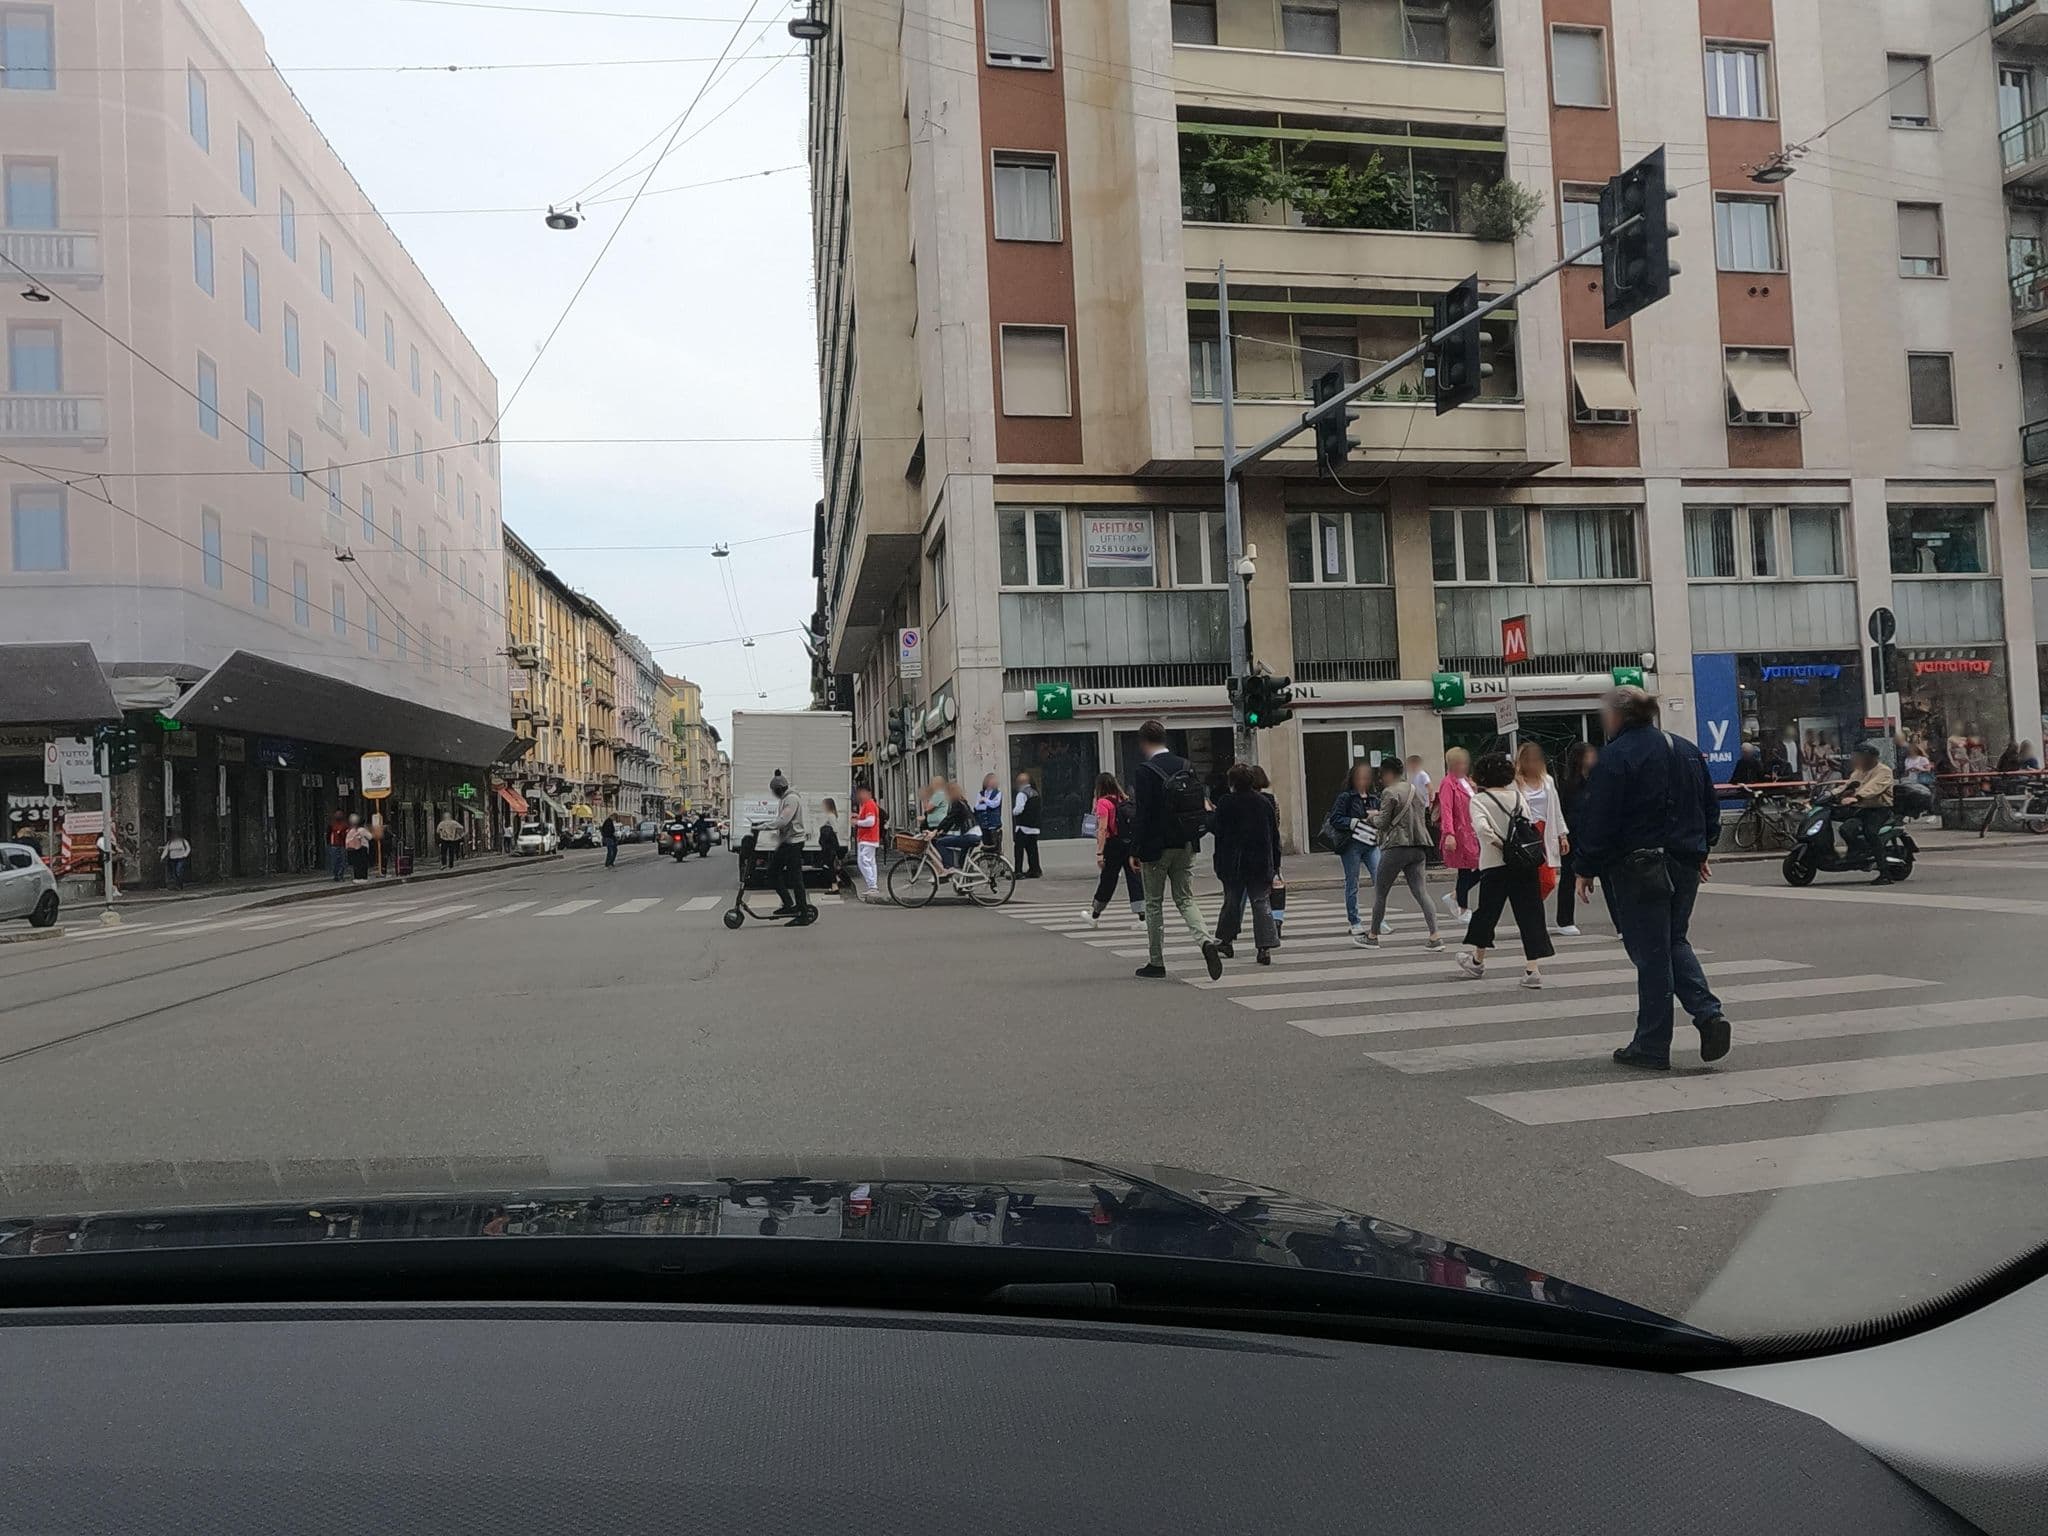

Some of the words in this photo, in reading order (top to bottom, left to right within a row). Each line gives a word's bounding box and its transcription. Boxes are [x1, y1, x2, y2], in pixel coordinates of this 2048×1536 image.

[1506, 627, 1525, 656] M
[1916, 660, 1991, 676] yamamay
[1470, 681, 1506, 694] BNL
[1078, 692, 1121, 706] BNL
[1709, 751, 1732, 762] MAN
